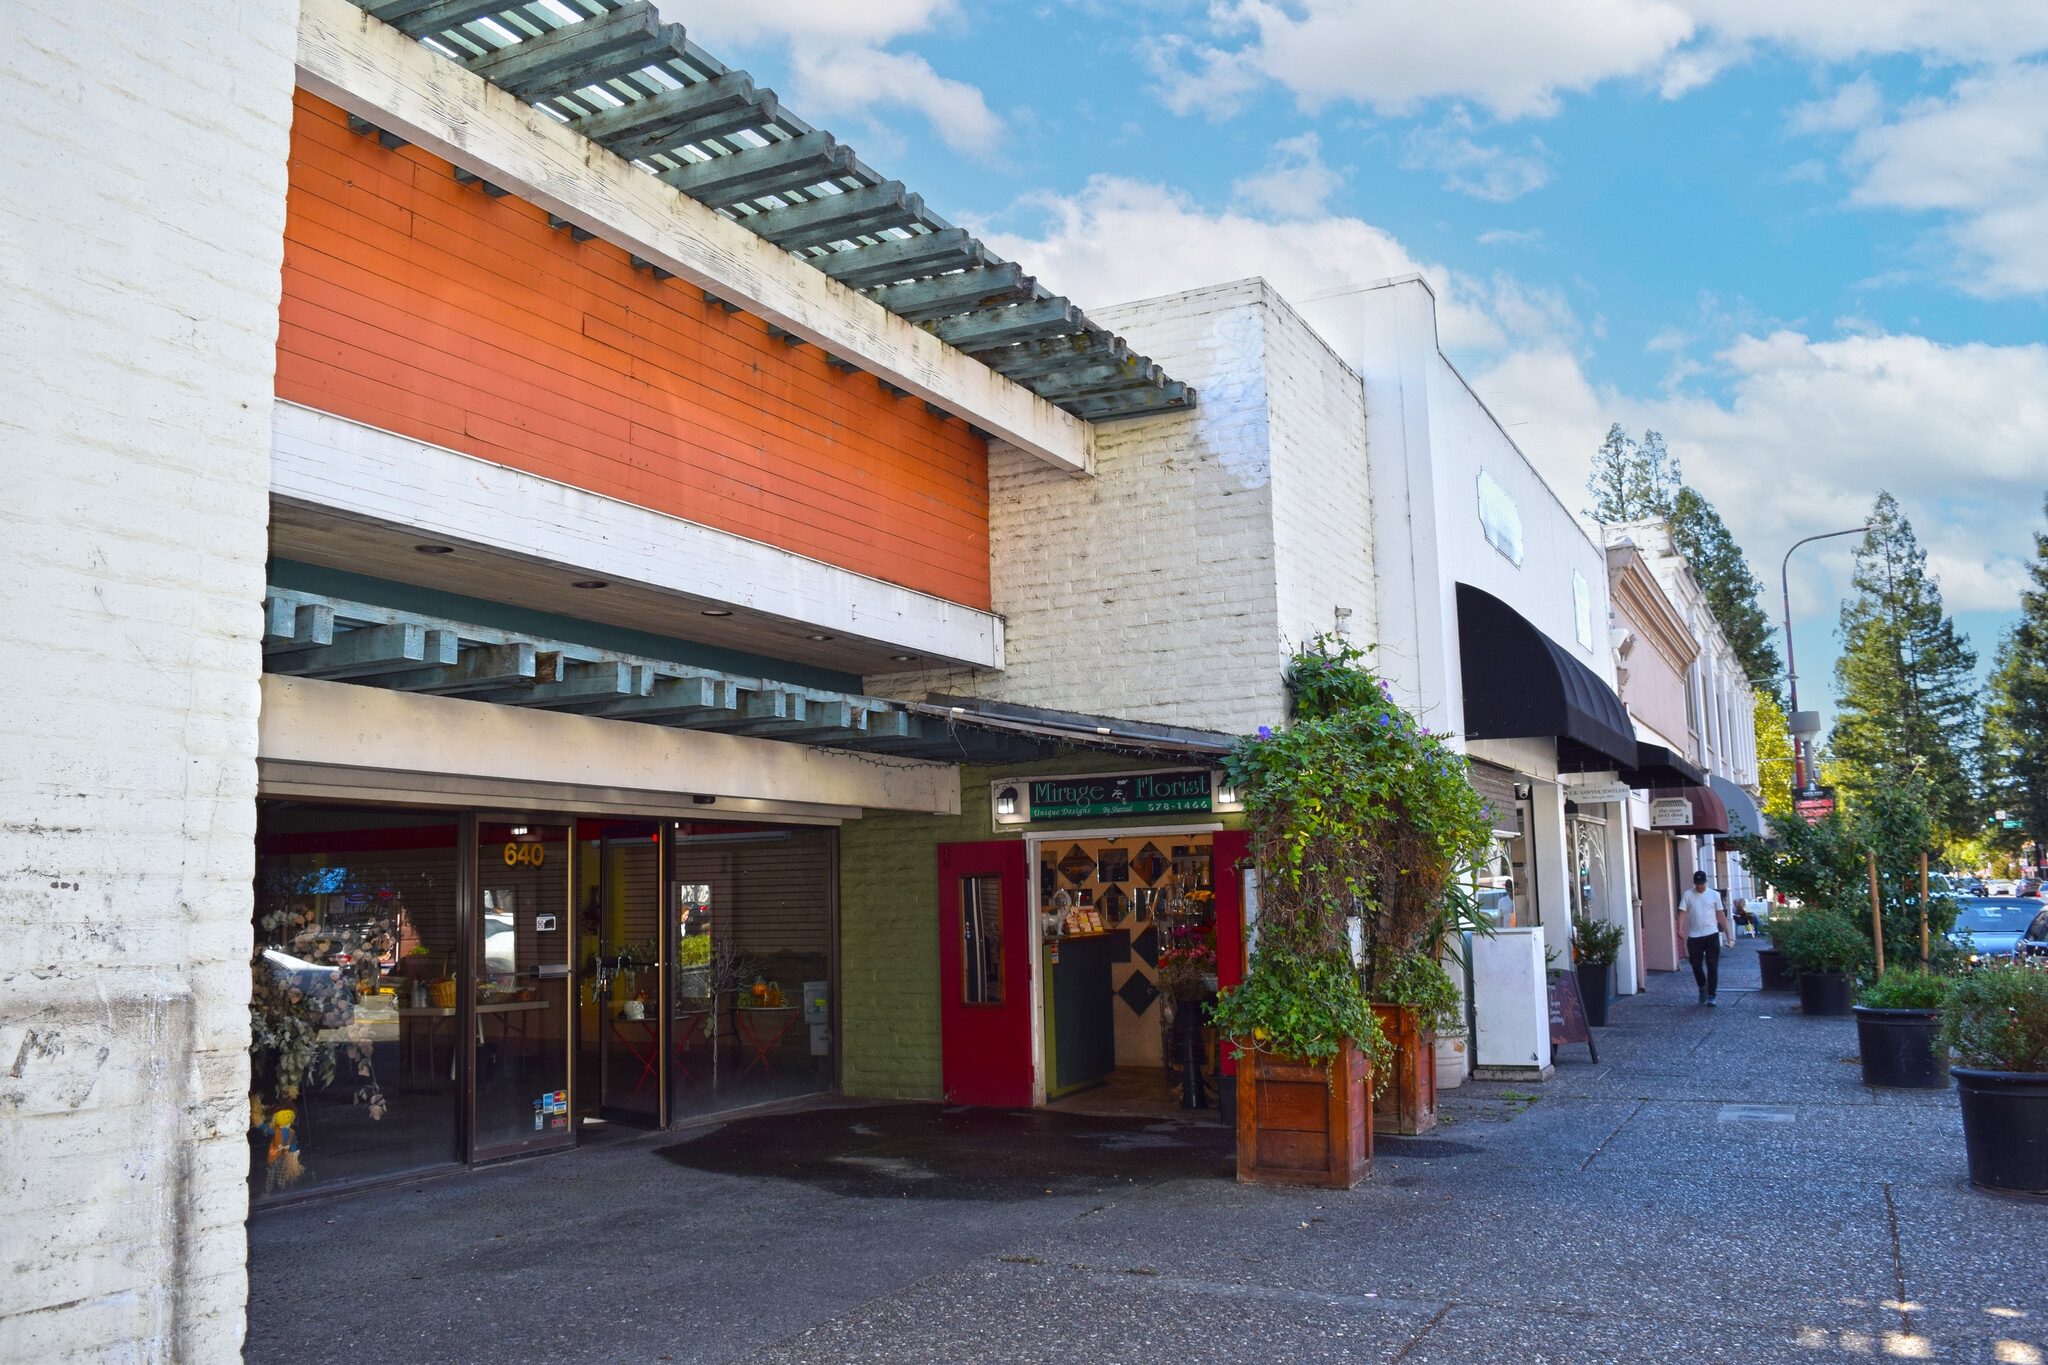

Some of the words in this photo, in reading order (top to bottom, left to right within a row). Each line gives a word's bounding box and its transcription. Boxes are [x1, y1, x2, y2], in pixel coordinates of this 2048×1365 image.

[1034, 782, 1104, 809] Mirage
[1134, 775, 1210, 798] Florist
[1602, 787, 1629, 795] JEWELERS
[1033, 809, 1060, 819] Unique
[1062, 807, 1091, 817] Designs
[1147, 800, 1208, 811] 578-1466
[504, 842, 544, 866] 640
